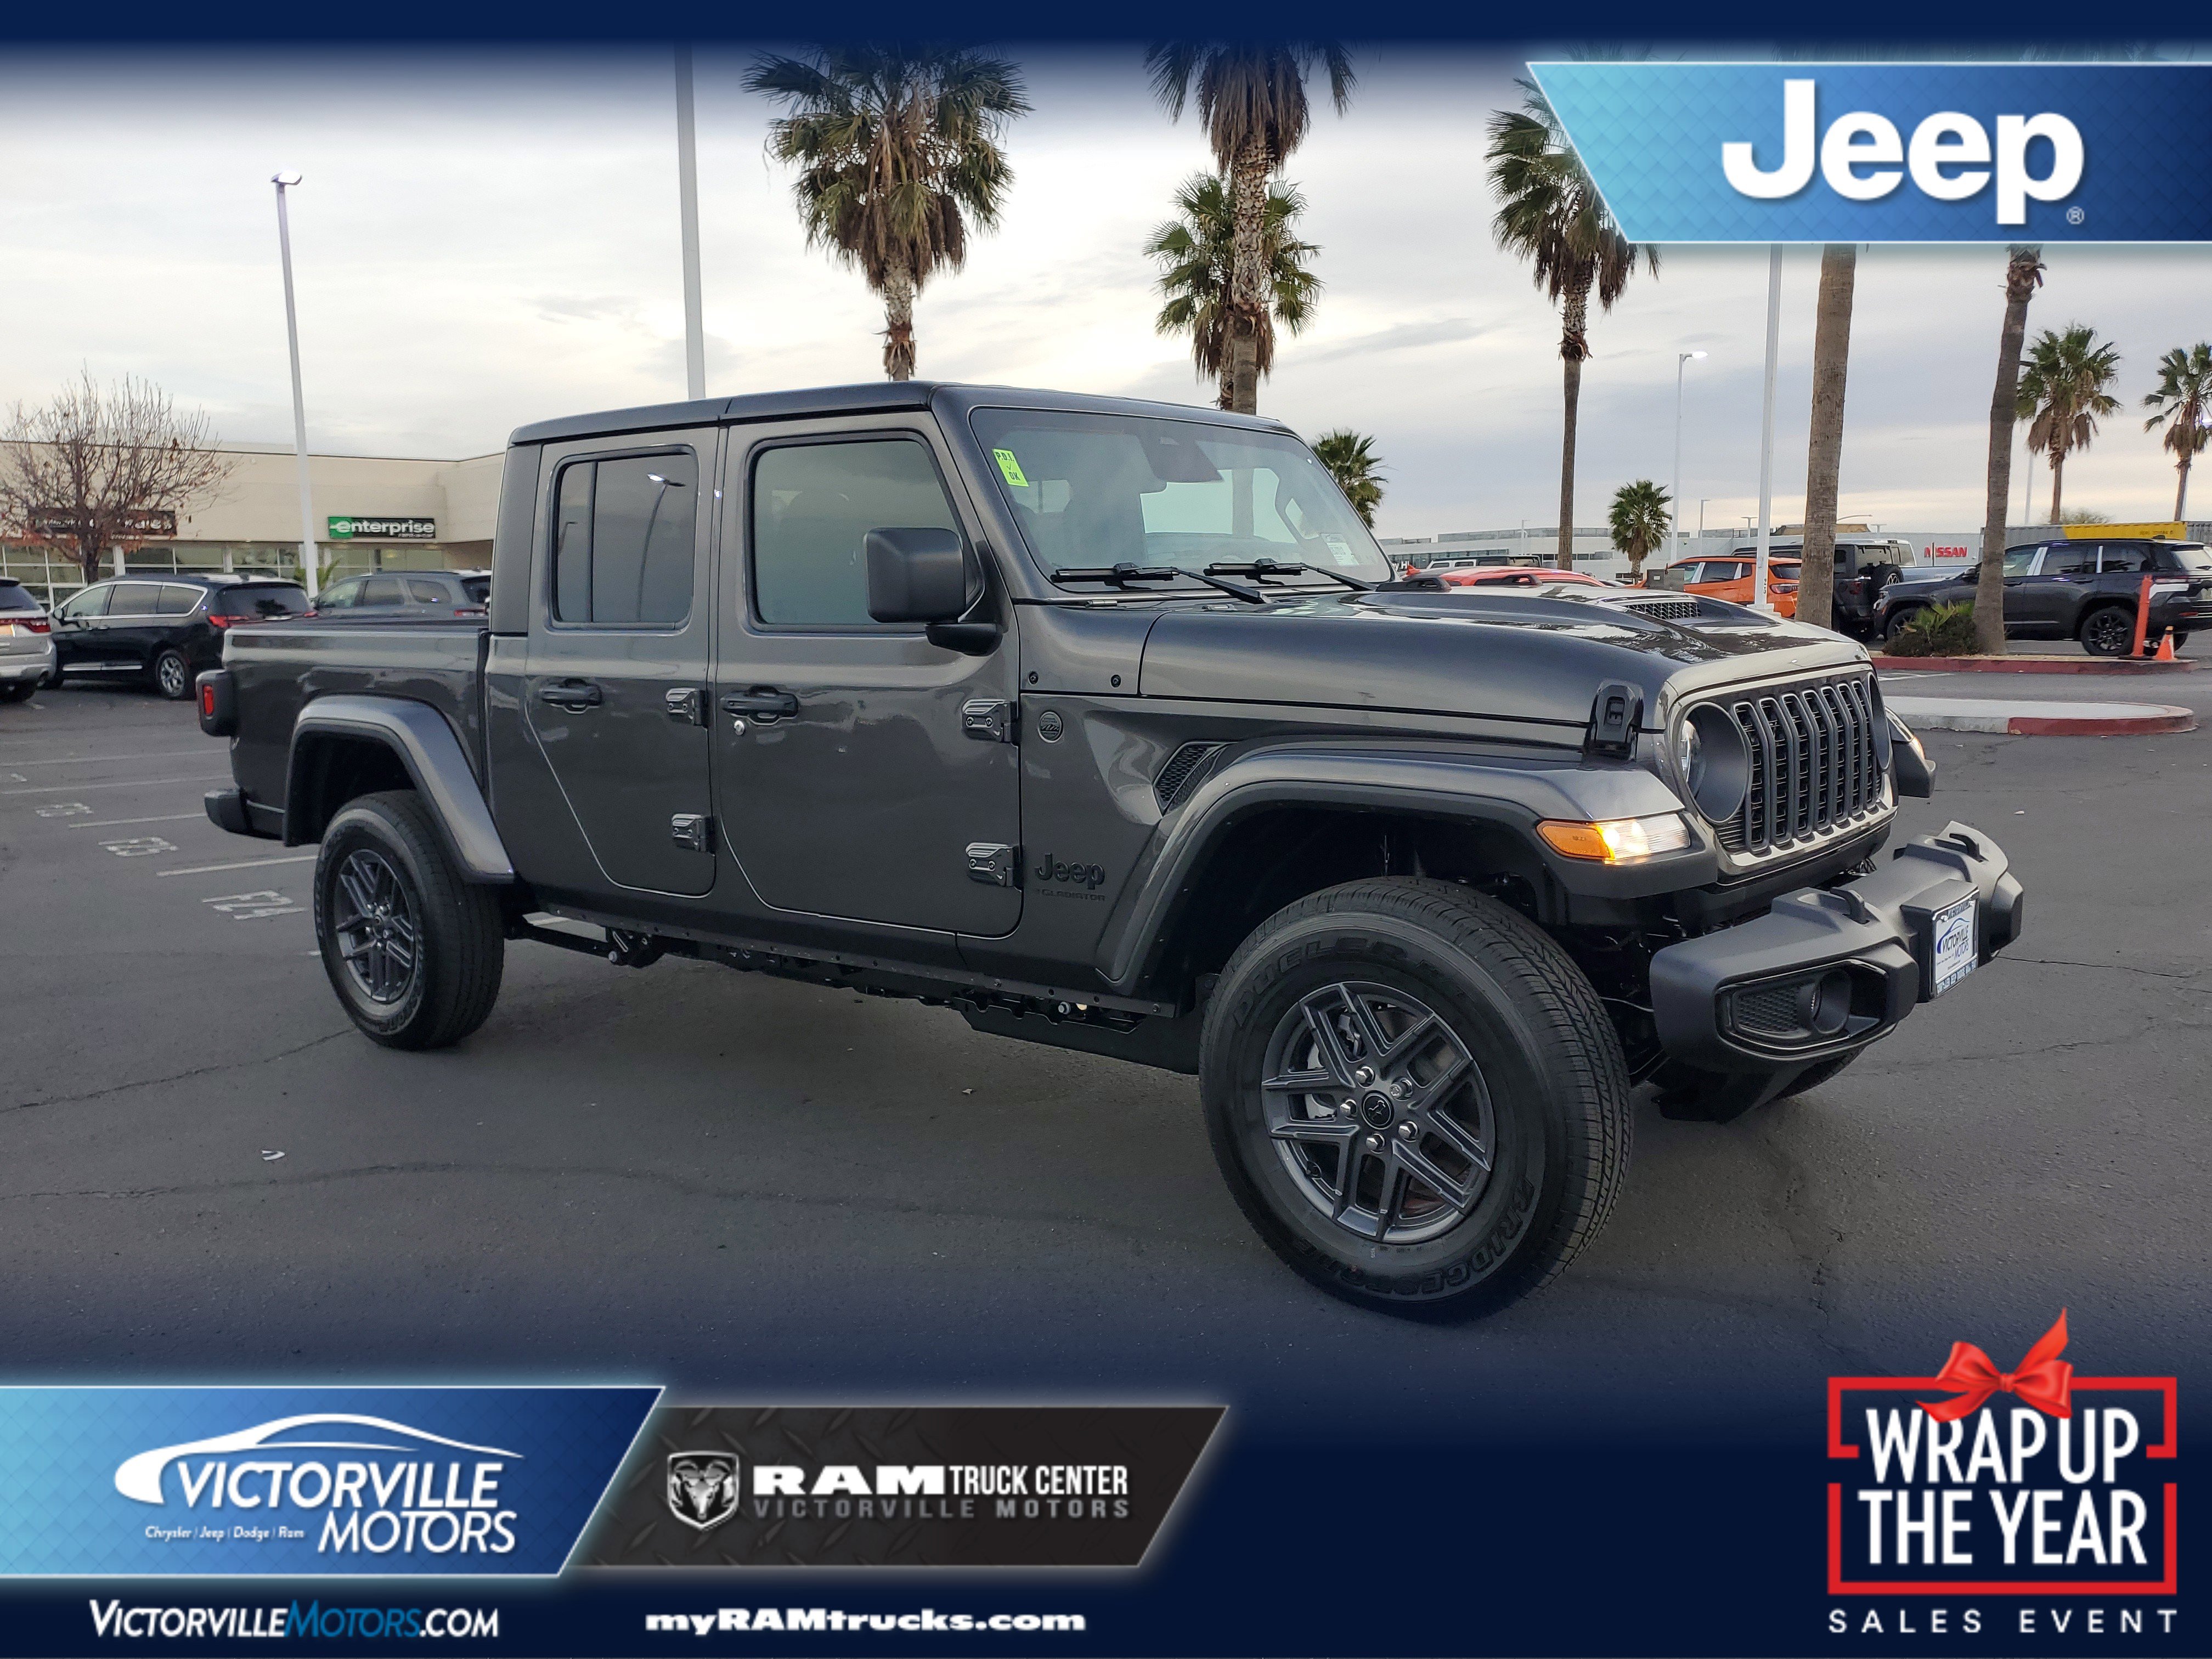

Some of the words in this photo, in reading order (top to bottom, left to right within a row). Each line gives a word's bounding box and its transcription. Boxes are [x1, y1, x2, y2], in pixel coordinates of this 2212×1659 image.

[1008, 471, 1021, 481] OK
[330, 520, 435, 535] enterprise
[1923, 546, 1967, 557] NISSAN
[1034, 852, 1105, 890] Jeep
